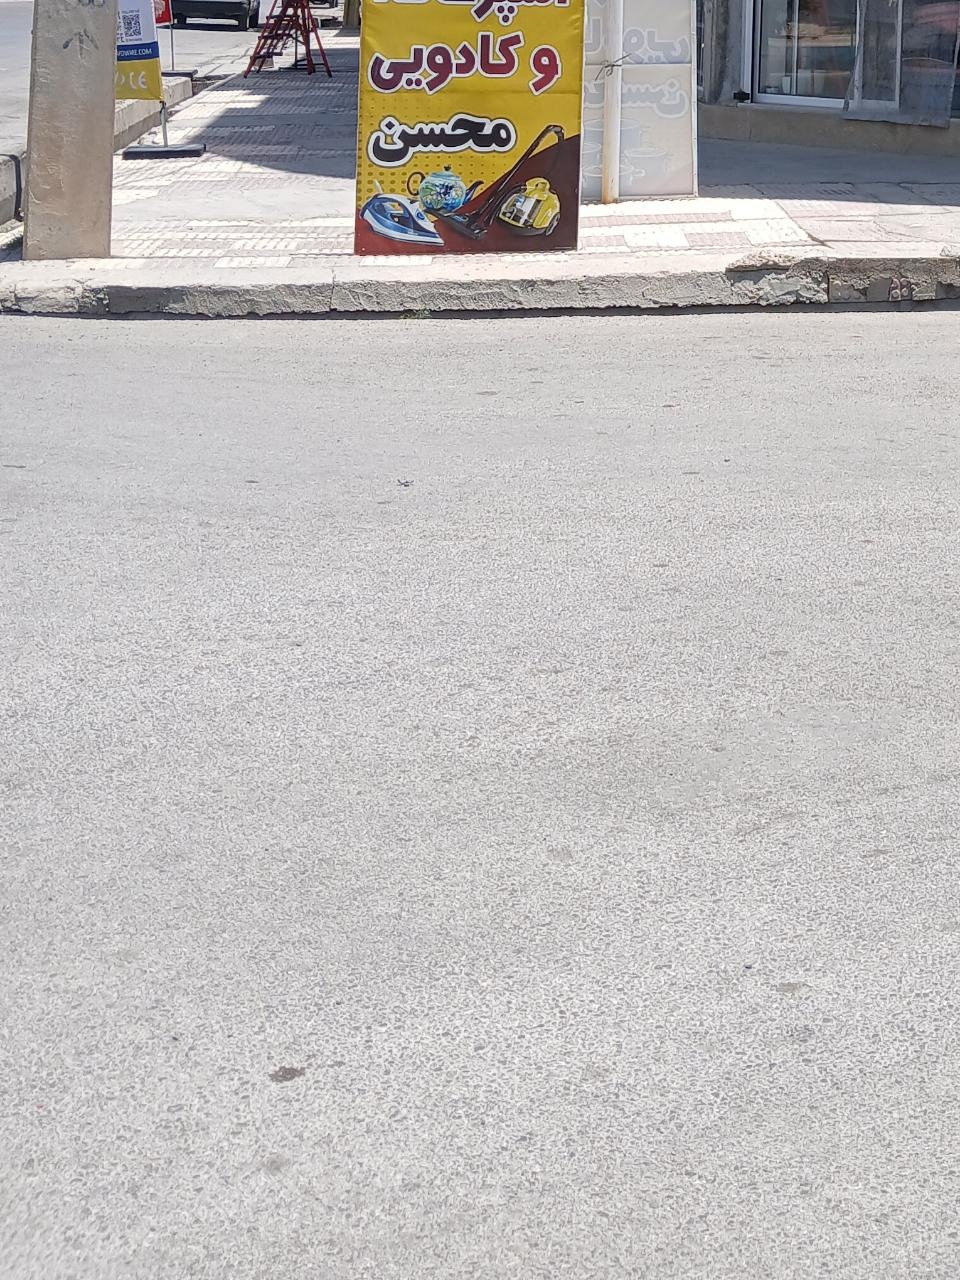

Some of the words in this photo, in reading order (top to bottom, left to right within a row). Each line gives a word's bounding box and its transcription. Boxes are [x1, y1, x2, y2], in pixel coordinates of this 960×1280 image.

[370, 32, 522, 92] کادویی
[531, 48, 561, 93] و
[371, 114, 513, 163] محسن
